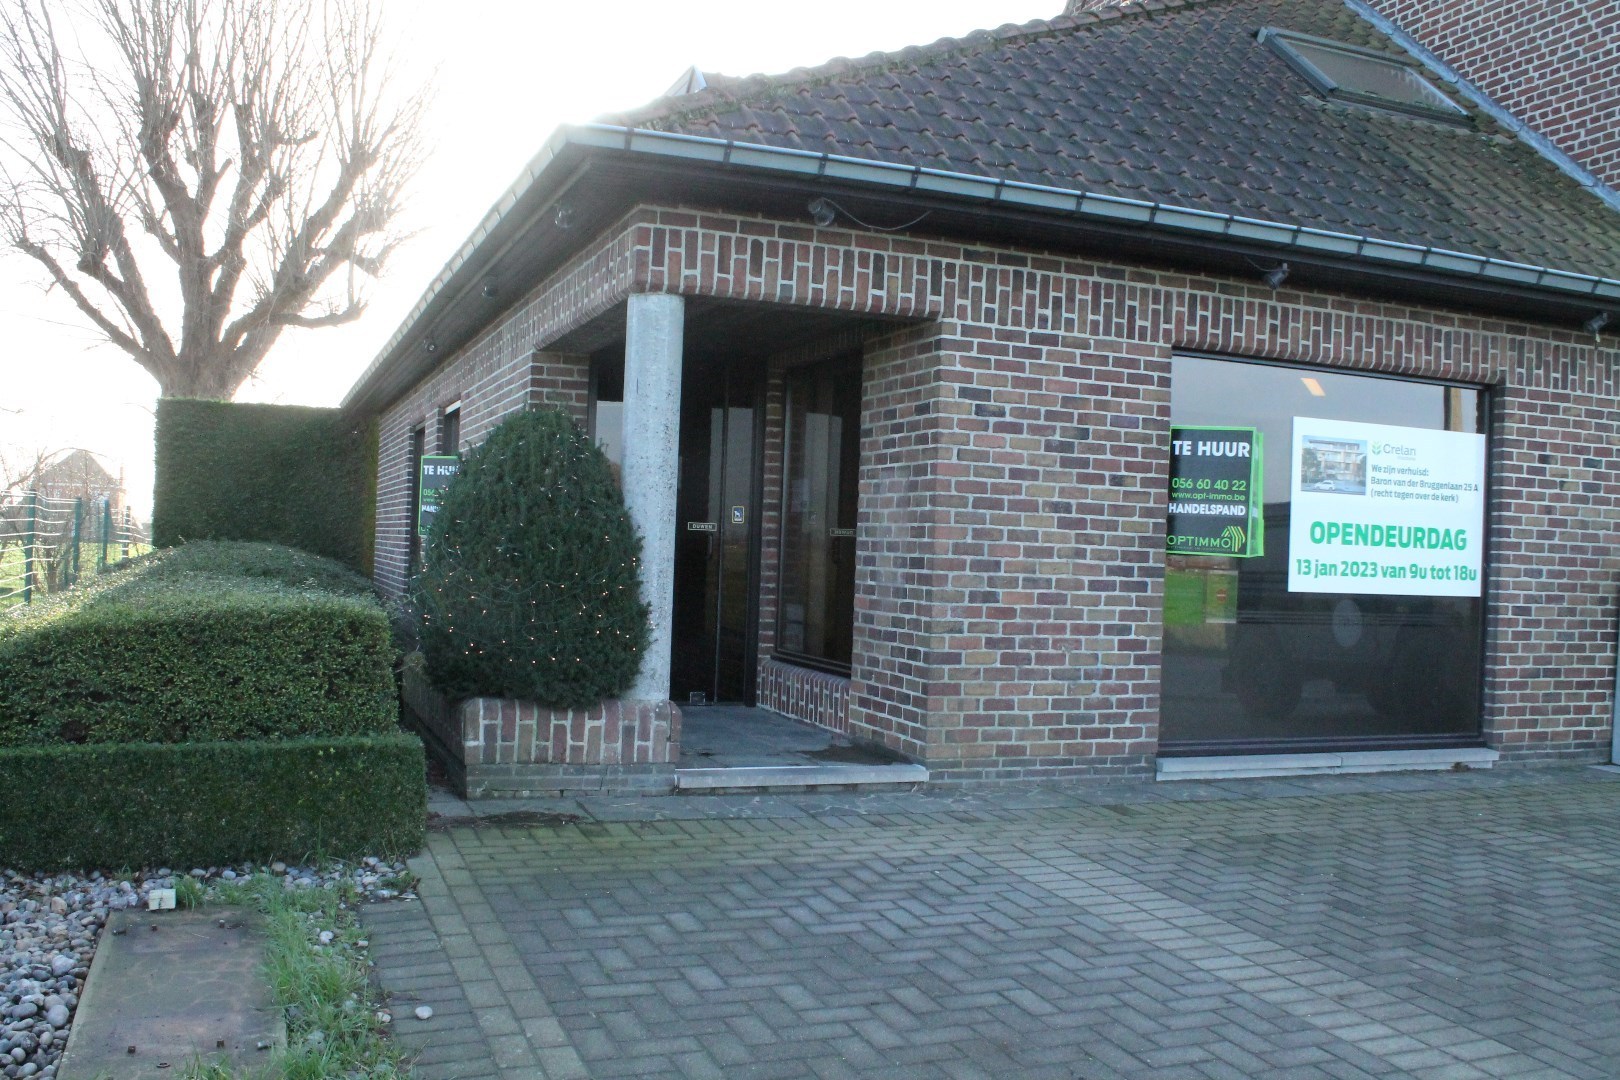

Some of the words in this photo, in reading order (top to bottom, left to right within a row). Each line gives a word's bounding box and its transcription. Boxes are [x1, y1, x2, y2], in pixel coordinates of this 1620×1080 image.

[1173, 440, 1192, 456] TE
[1197, 441, 1250, 458] HUUR
[1383, 444, 1416, 456] Crelan
[424, 465, 434, 475] TE
[1372, 464, 1382, 472] We
[1383, 466, 1396, 475] zijn
[1396, 466, 1429, 476] verhuisd:
[1172, 478, 1193, 489] 056
[1196, 479, 1211, 490] 60
[1214, 480, 1229, 490] 40
[1232, 480, 1246, 491] 22
[1370, 476, 1392, 486] Baron
[1406, 479, 1418, 488] der
[1420, 480, 1462, 491] Bruggenlaan
[1473, 484, 1478, 492] A
[1172, 492, 1246, 502] www.opt-immo.be
[1370, 488, 1392, 498] (recht
[1394, 490, 1414, 500] tegen
[1430, 492, 1440, 501] de
[1440, 493, 1459, 503] kerk)
[1168, 503, 1246, 516] HANDELSPAND
[1166, 535, 1231, 548] OPTIMMO
[1309, 520, 1467, 551] OPENDEURDAG
[1296, 558, 1311, 576] 13
[1314, 560, 1338, 579] jan
[1340, 560, 1378, 578] 2023
[1380, 564, 1406, 579] van
[1409, 564, 1428, 580] 9u
[1430, 565, 1451, 580] tot
[1454, 565, 1477, 582] 18u
